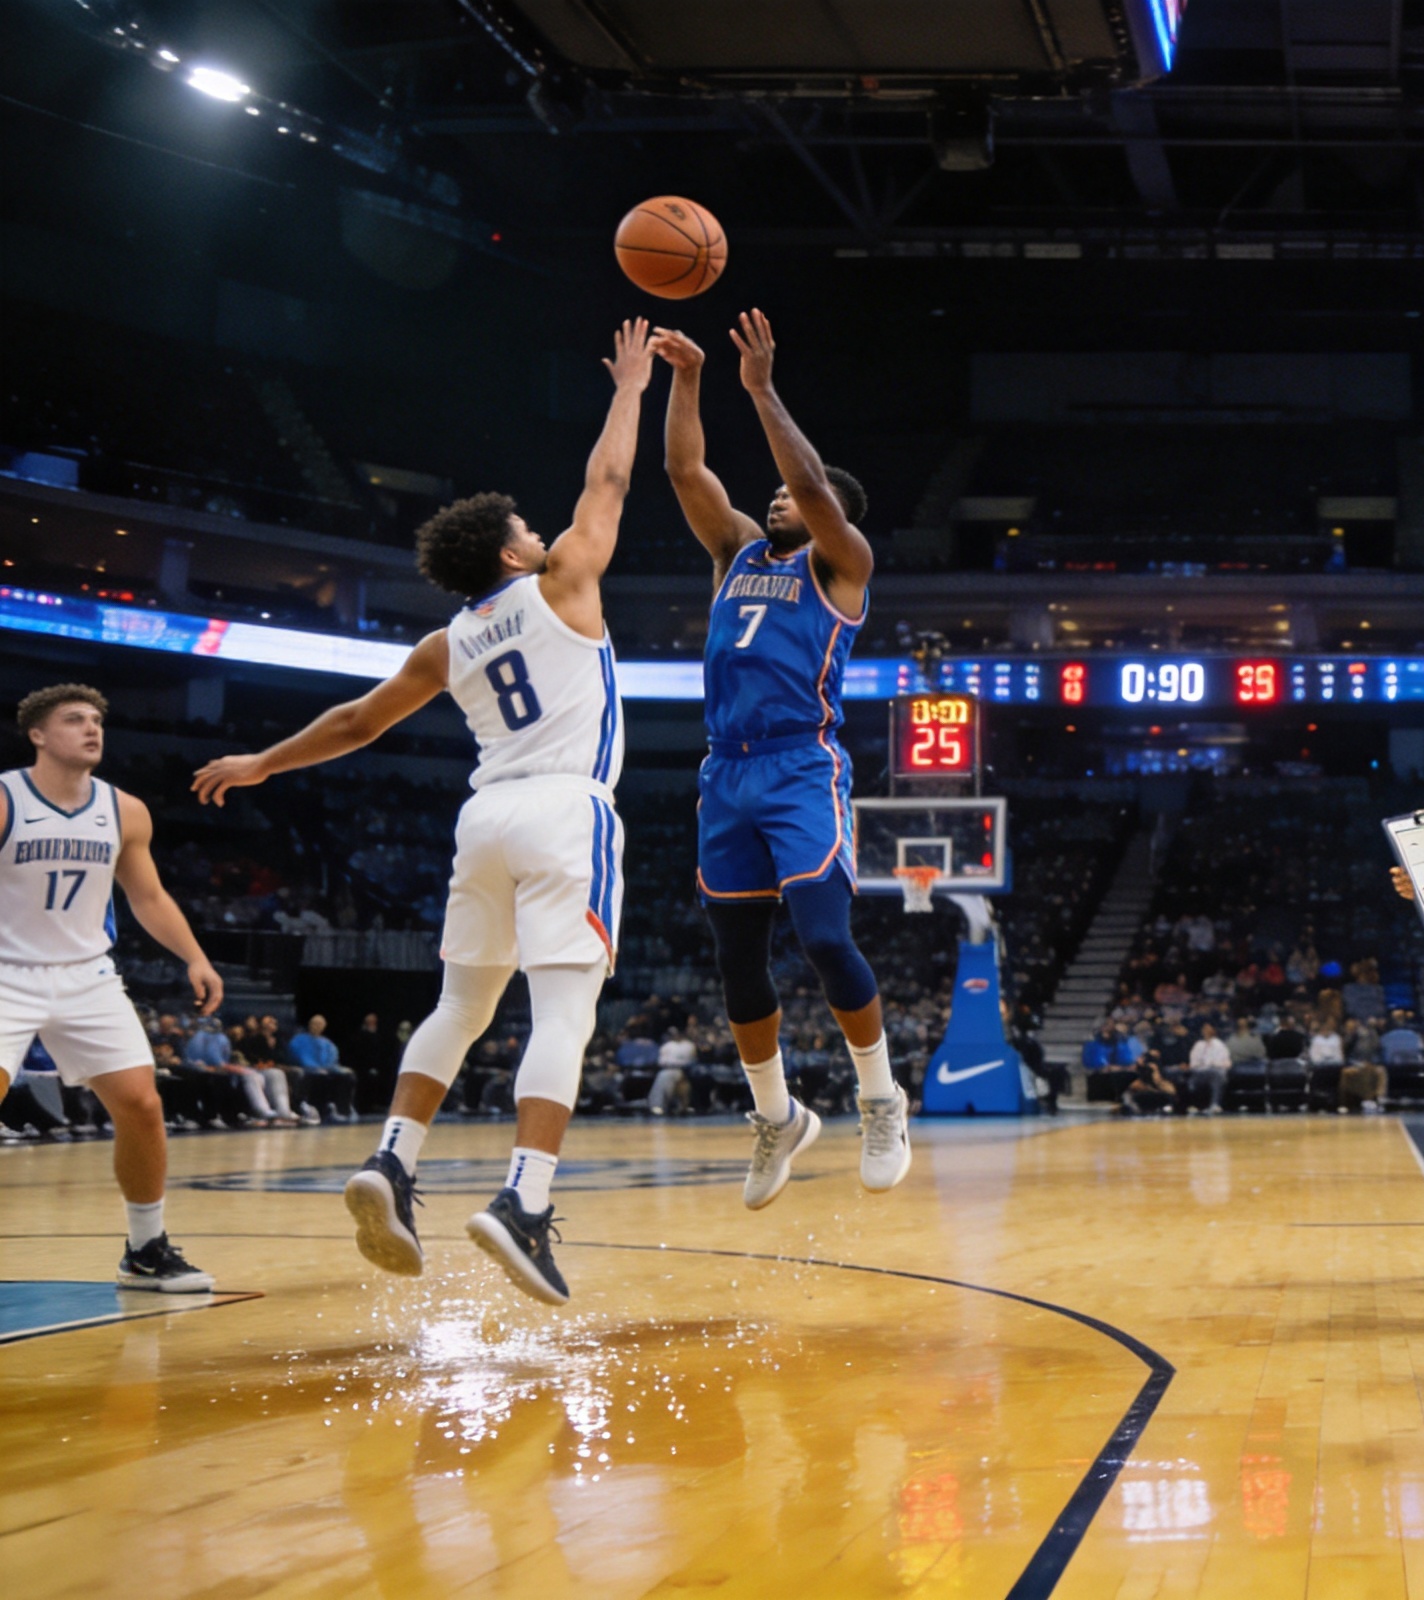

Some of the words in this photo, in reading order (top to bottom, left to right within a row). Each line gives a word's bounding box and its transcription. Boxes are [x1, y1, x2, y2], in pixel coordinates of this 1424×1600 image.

[734, 604, 767, 648] 7
[485, 649, 542, 732] 8
[1121, 663, 1204, 702] 0:90
[912, 727, 961, 765] 25
[45, 870, 87, 911] 17
